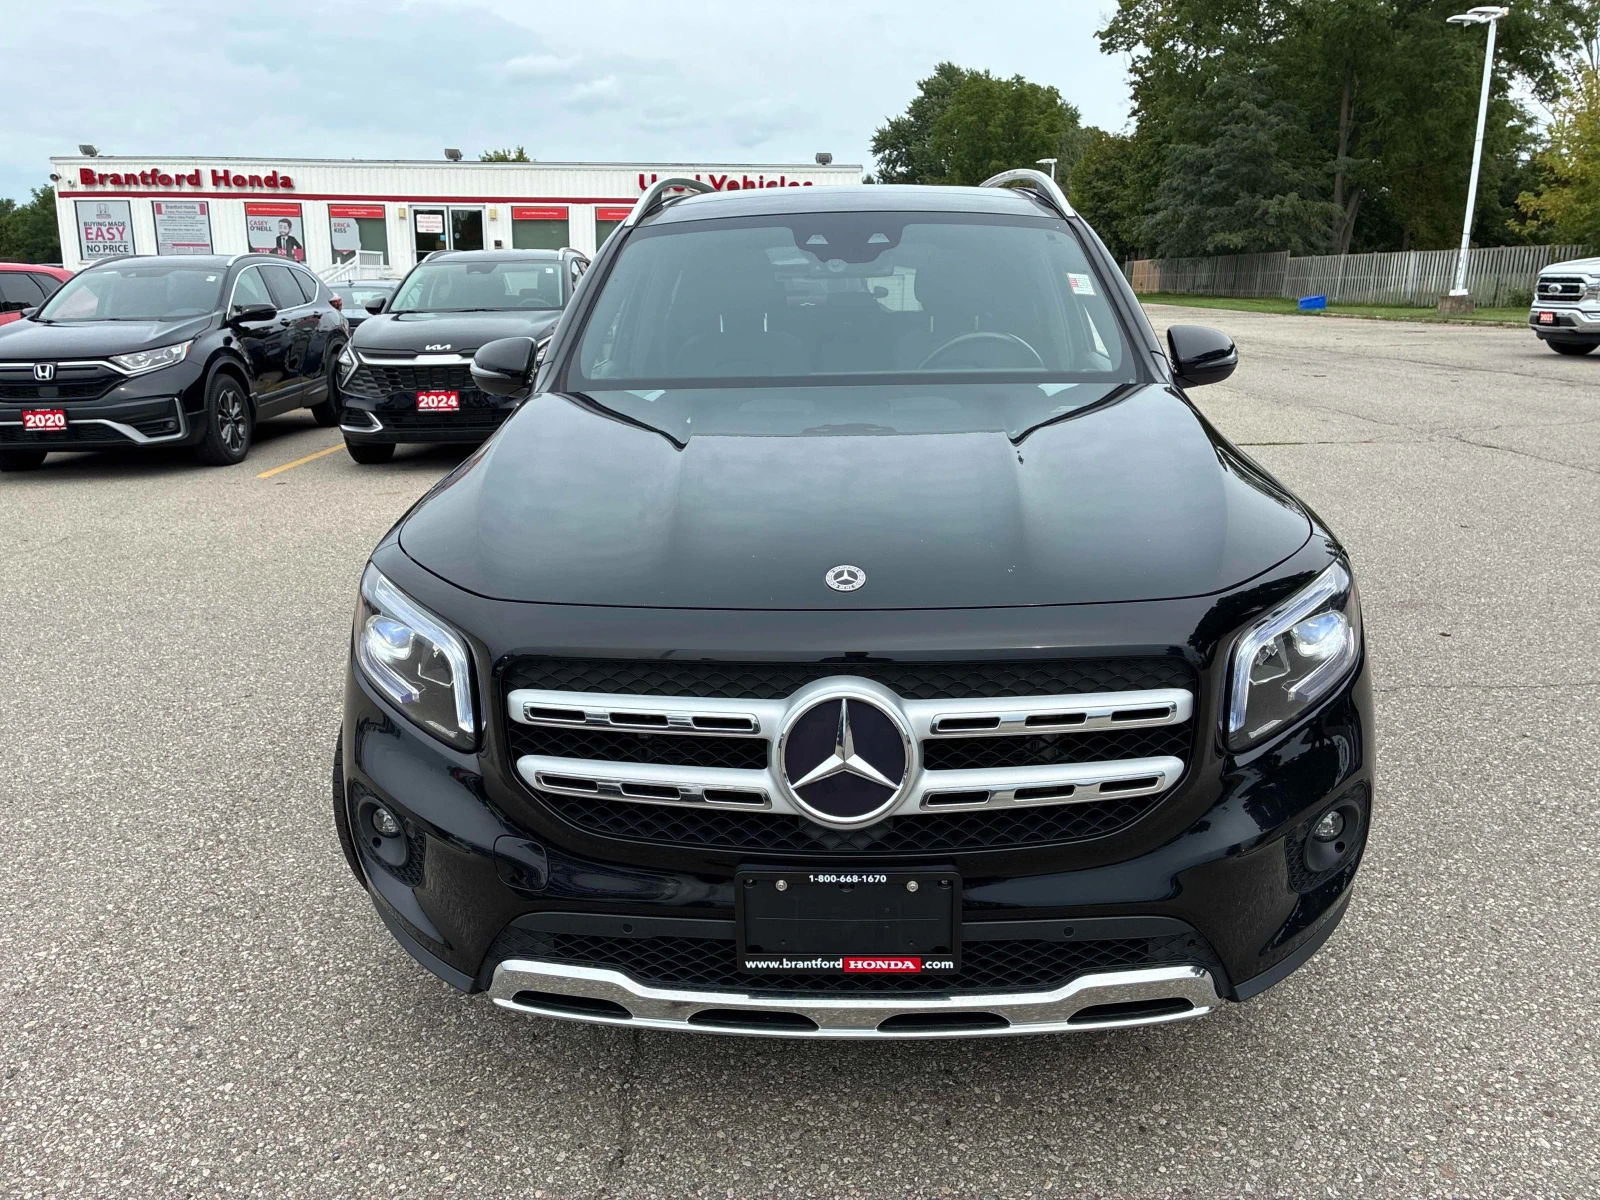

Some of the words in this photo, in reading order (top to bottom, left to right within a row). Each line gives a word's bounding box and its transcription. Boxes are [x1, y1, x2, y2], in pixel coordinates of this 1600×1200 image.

[79, 168, 200, 186] Brantford
[211, 169, 294, 188] Honda
[84, 226, 126, 241] EASY
[86, 244, 101, 253] NO
[102, 244, 129, 253] PRICE
[418, 395, 458, 408] 2024
[25, 413, 65, 427] 2020
[808, 874, 887, 883] 1-800-668-1670
[745, 958, 843, 969] www.brantford
[848, 960, 917, 969] HONDA
